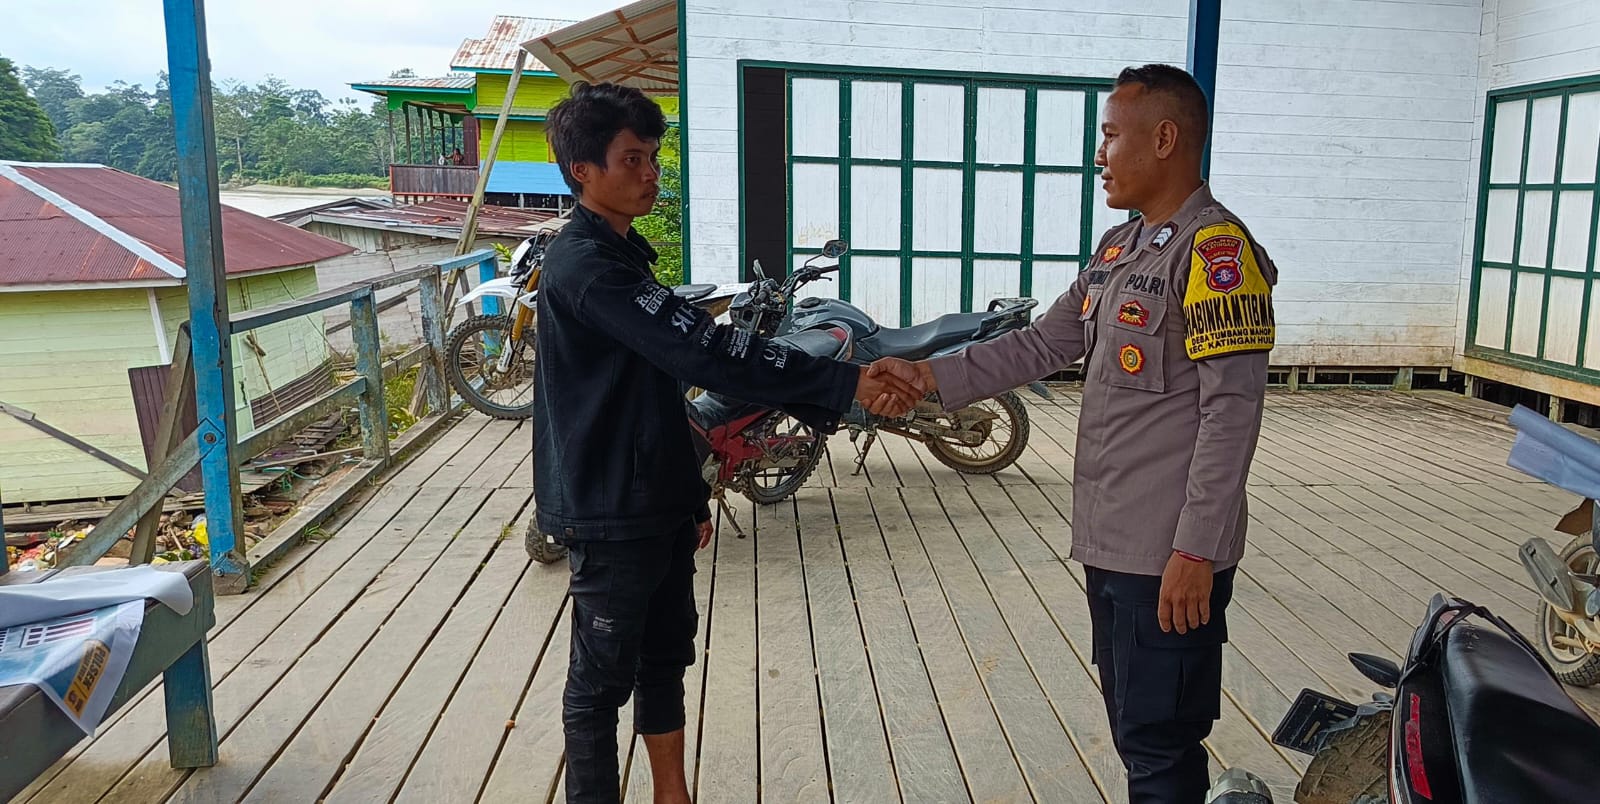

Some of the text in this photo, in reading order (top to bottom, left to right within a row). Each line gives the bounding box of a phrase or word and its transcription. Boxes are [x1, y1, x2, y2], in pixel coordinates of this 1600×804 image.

[1124, 273, 1165, 297] POLRI
[1184, 292, 1275, 340] HABINKAMTIBMA
[1189, 335, 1275, 354] KEC. KATINGAN HUL
[1191, 333, 1210, 346] DESA
[1210, 328, 1249, 340] TUMBANG
[83, 646, 106, 691] POLSEK
